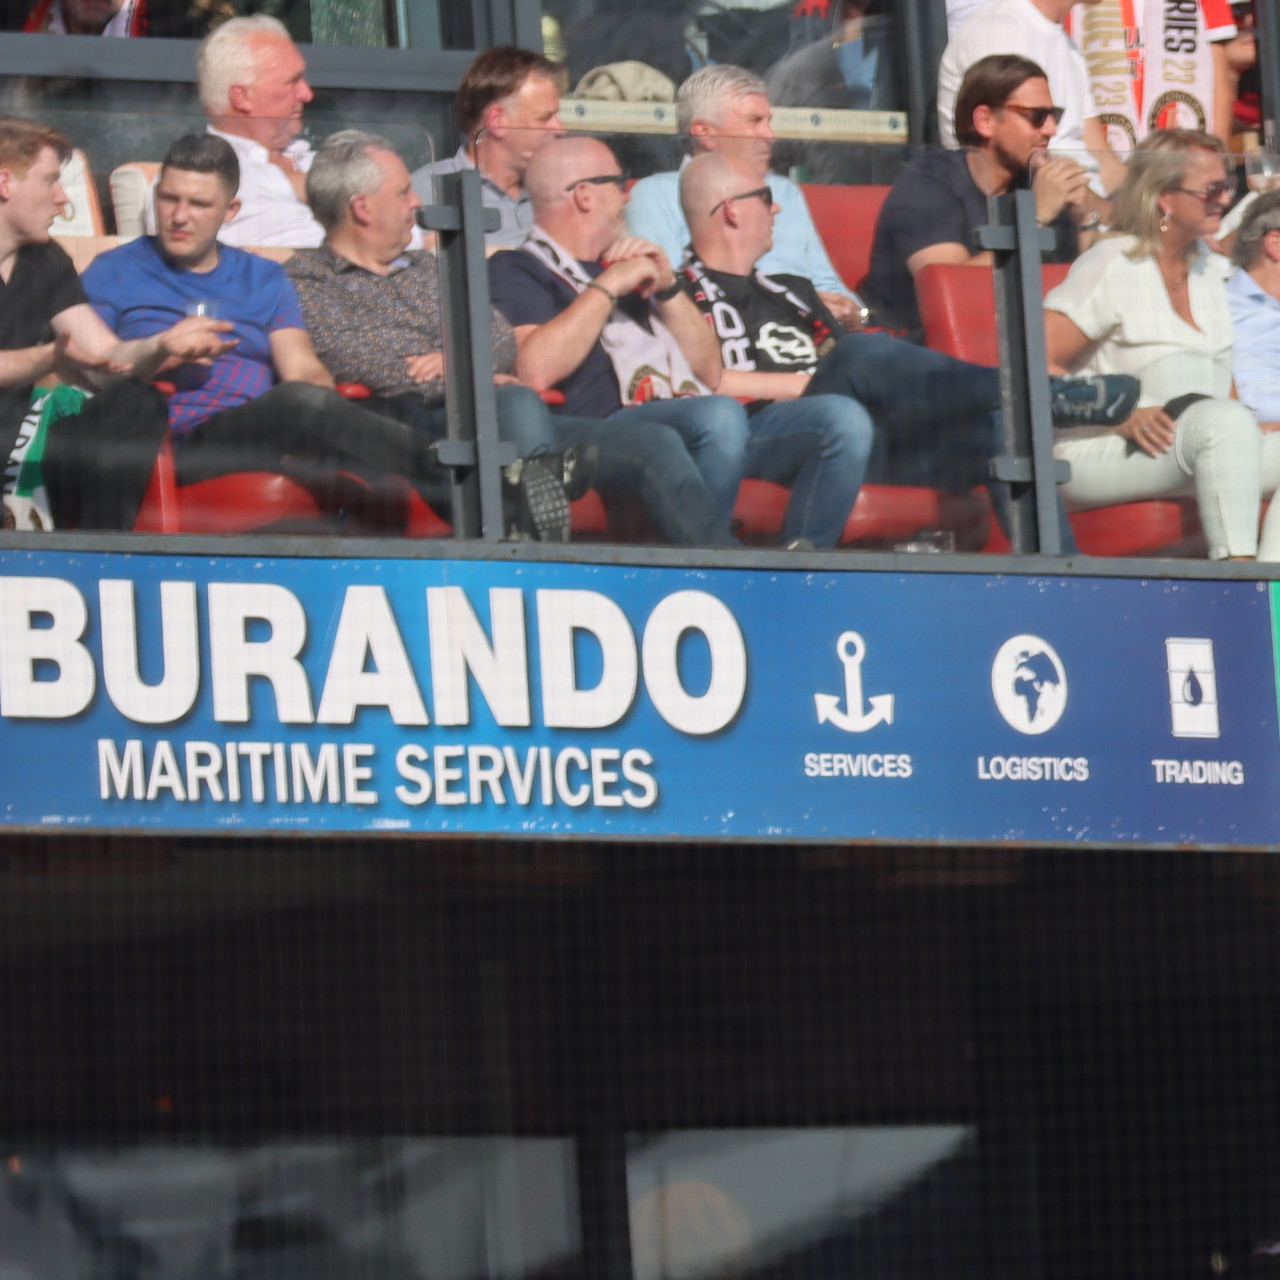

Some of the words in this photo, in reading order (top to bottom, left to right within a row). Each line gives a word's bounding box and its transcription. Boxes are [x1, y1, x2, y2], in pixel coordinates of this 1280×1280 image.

[0, 575, 748, 736] BURANDO
[97, 738, 379, 805] MARITIME
[394, 743, 658, 810] SERVICES
[803, 752, 914, 779] SERVICES
[977, 755, 1090, 783] LOGISTICS
[1151, 758, 1245, 786] TRADING
